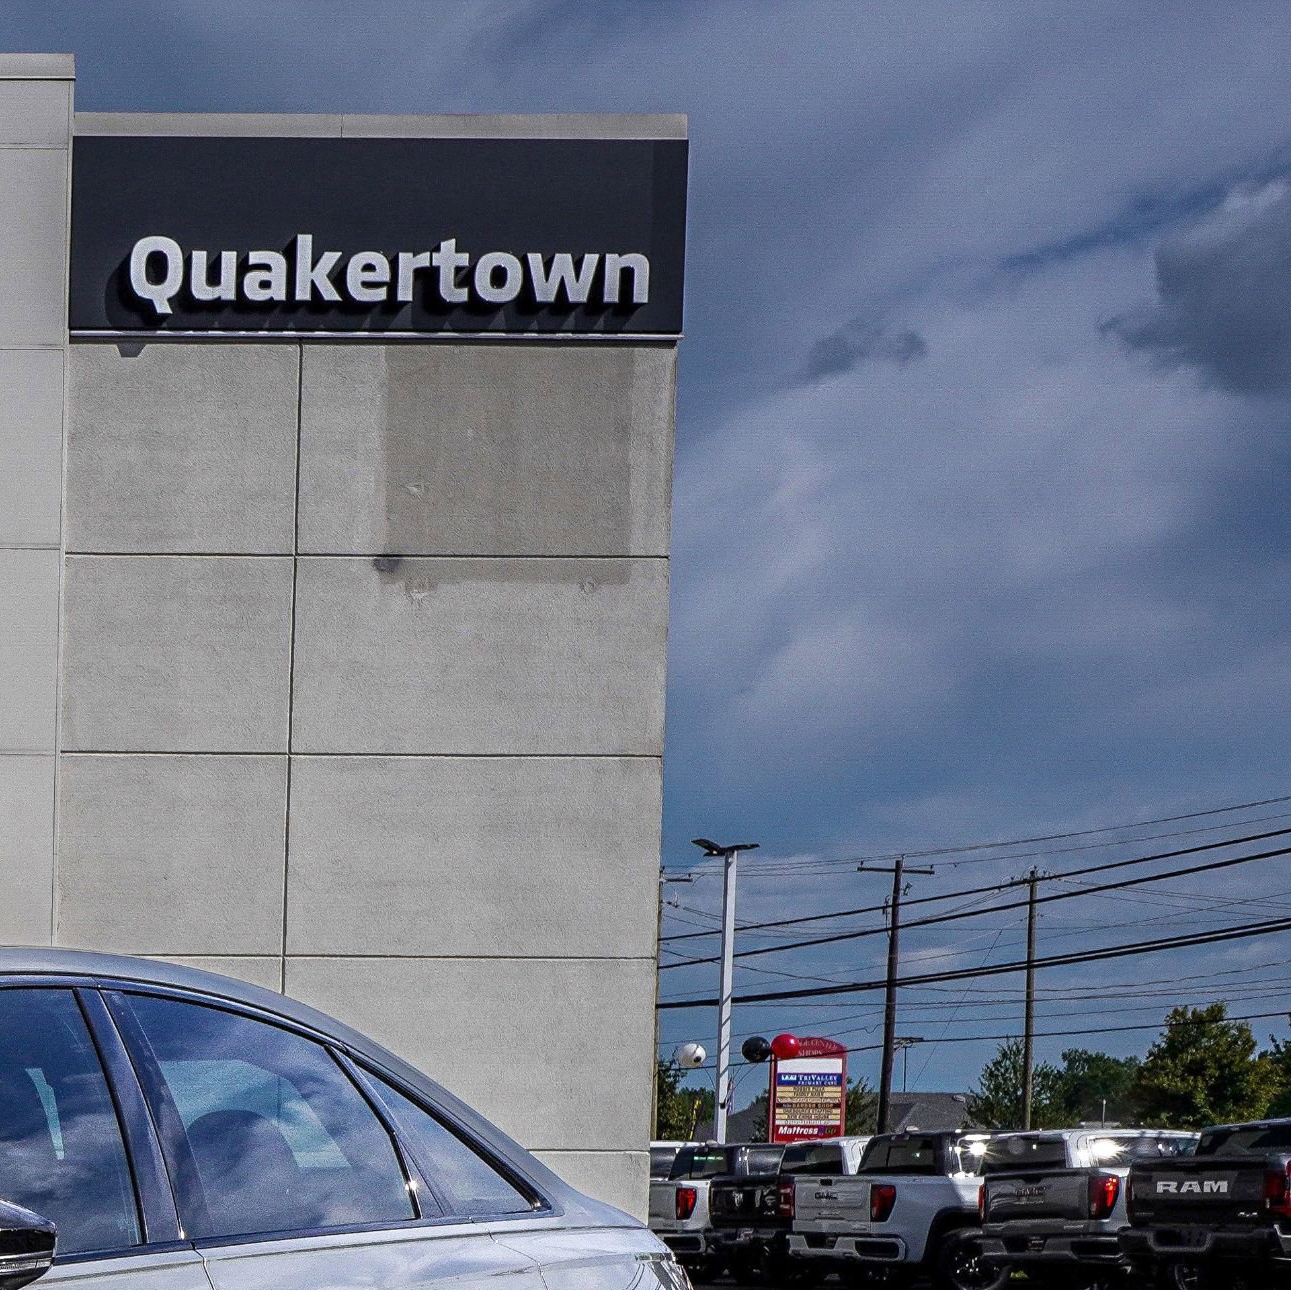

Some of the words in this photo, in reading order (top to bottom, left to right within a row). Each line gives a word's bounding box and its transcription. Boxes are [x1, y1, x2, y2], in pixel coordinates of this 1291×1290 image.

[129, 234, 650, 315] Quakertown
[778, 1126, 819, 1135] Mattress
[1156, 1180, 1228, 1194] RAM
